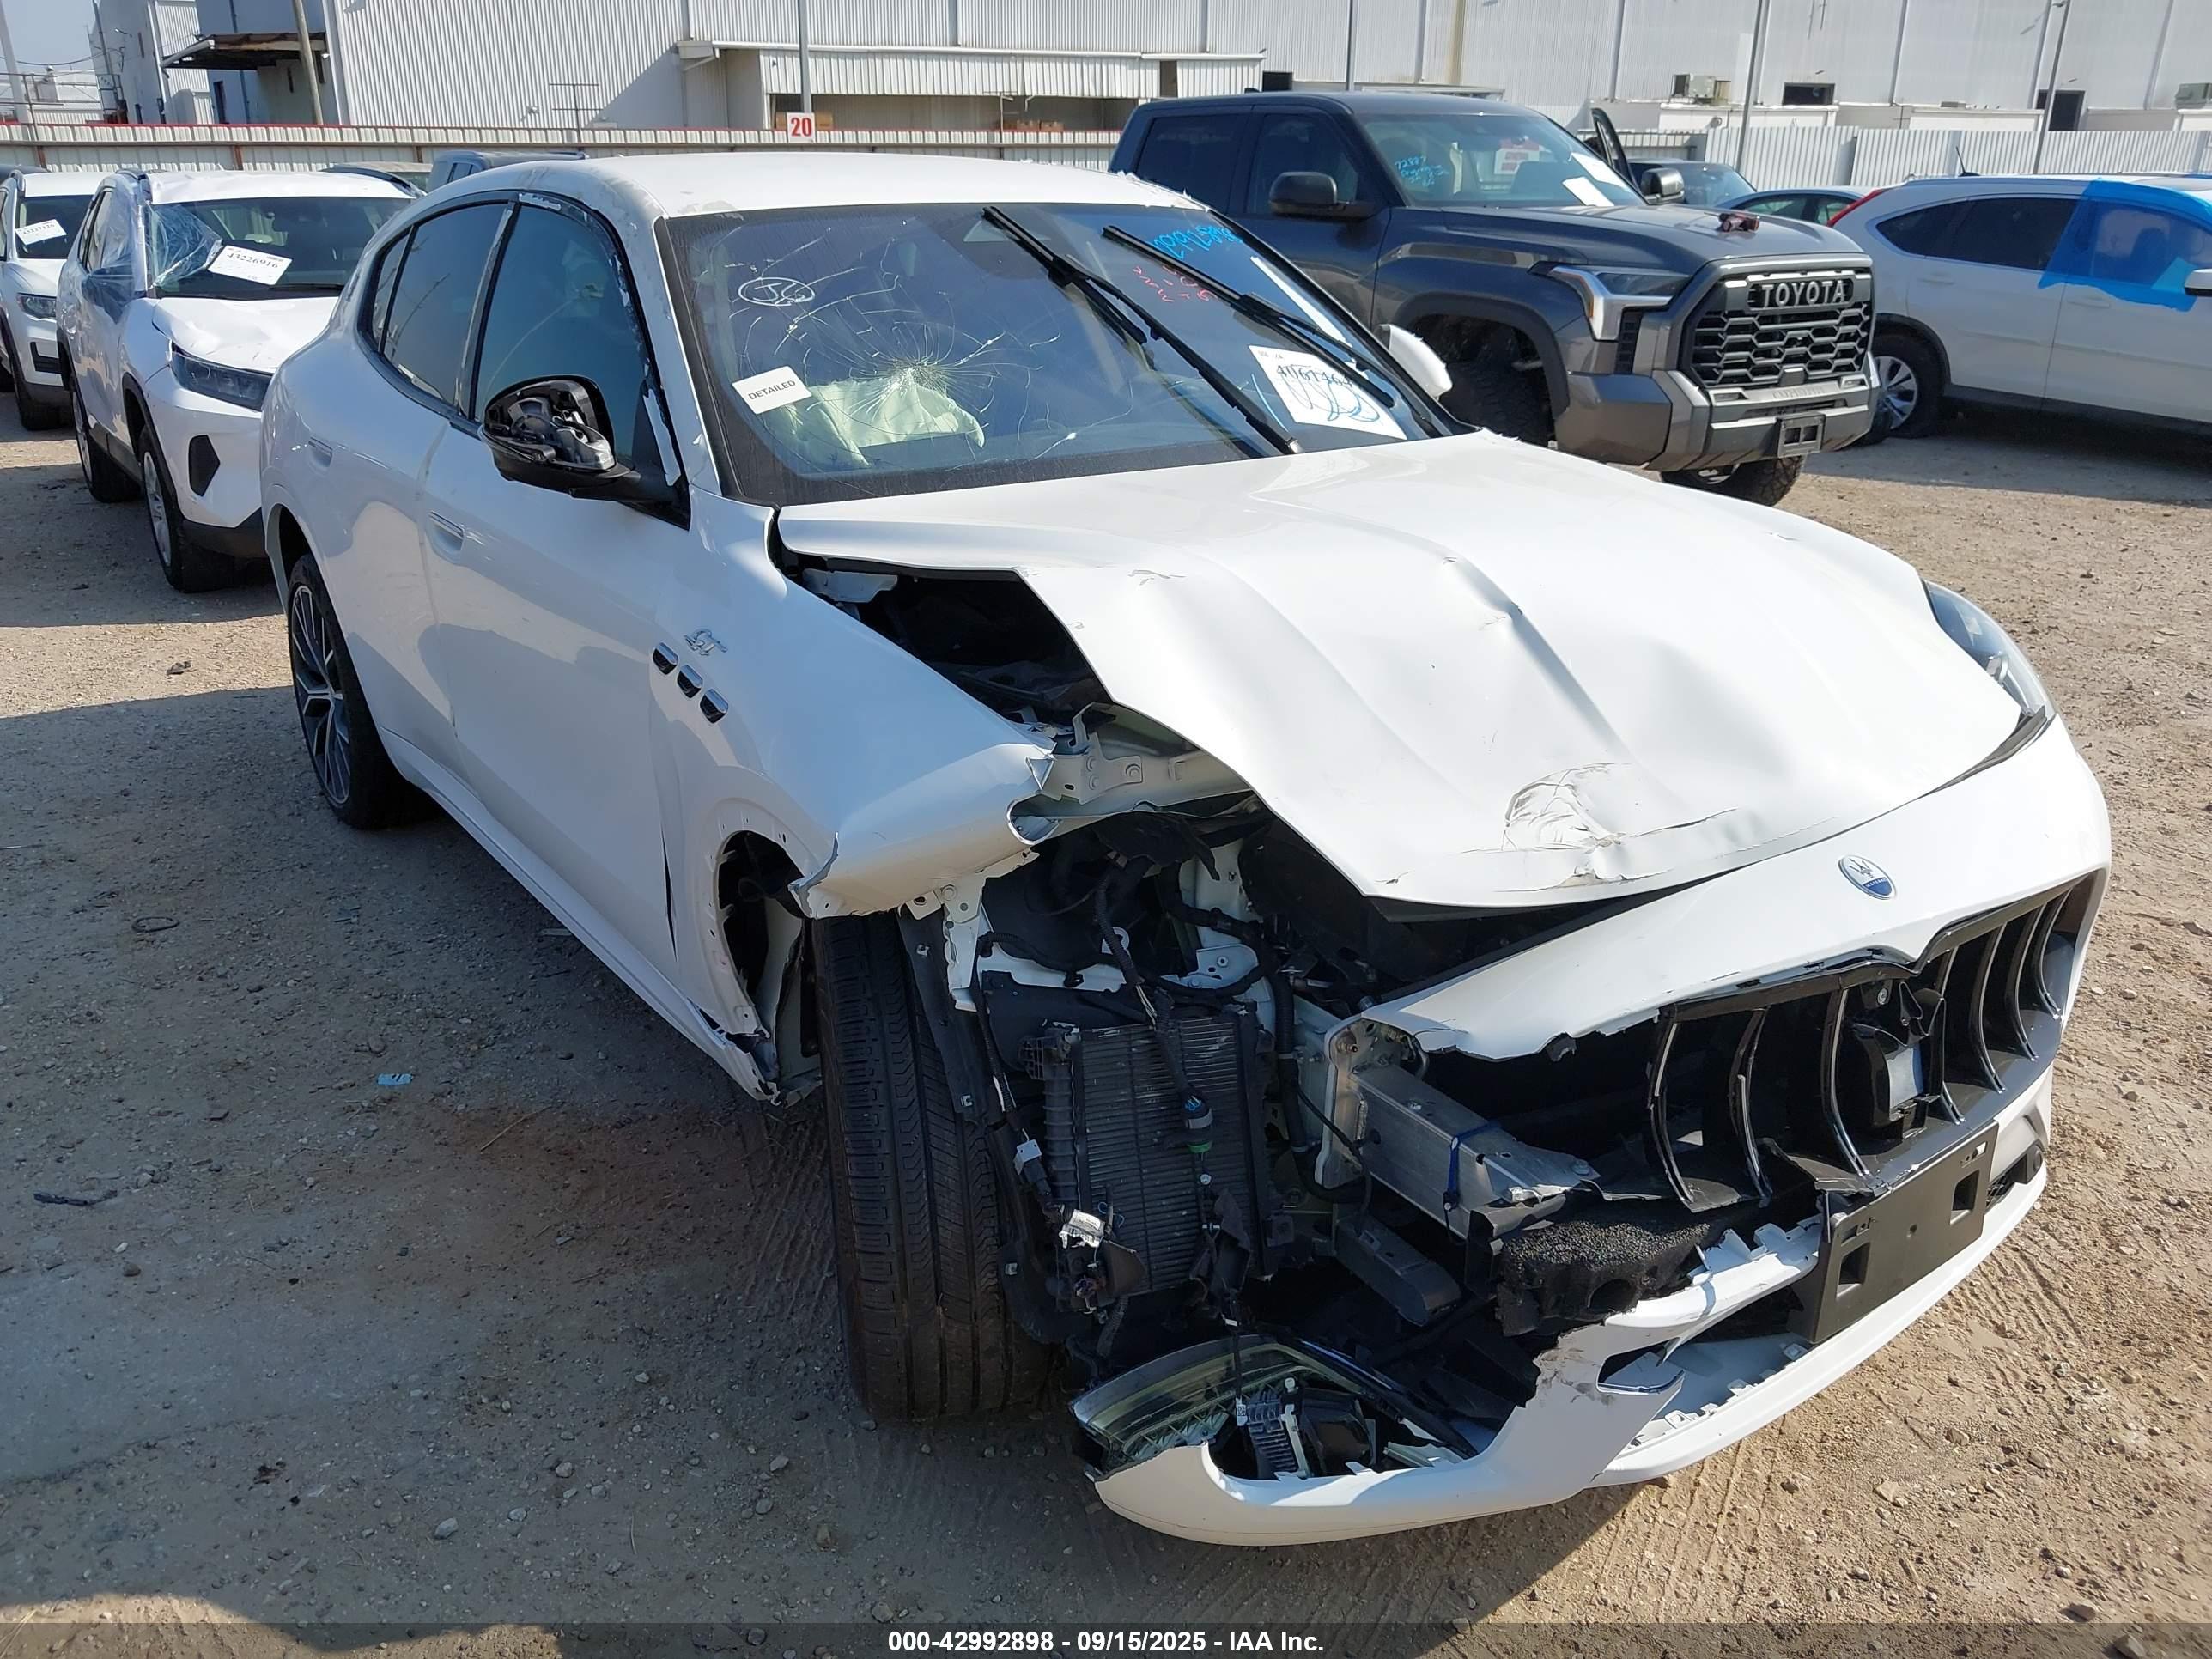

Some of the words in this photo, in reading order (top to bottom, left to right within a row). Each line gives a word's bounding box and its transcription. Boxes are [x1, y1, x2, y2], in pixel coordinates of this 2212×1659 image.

[791, 117, 811, 137] 20
[227, 252, 278, 268] 43226916
[1762, 280, 1845, 309] TOYOTA
[748, 380, 796, 400] DETAILED
